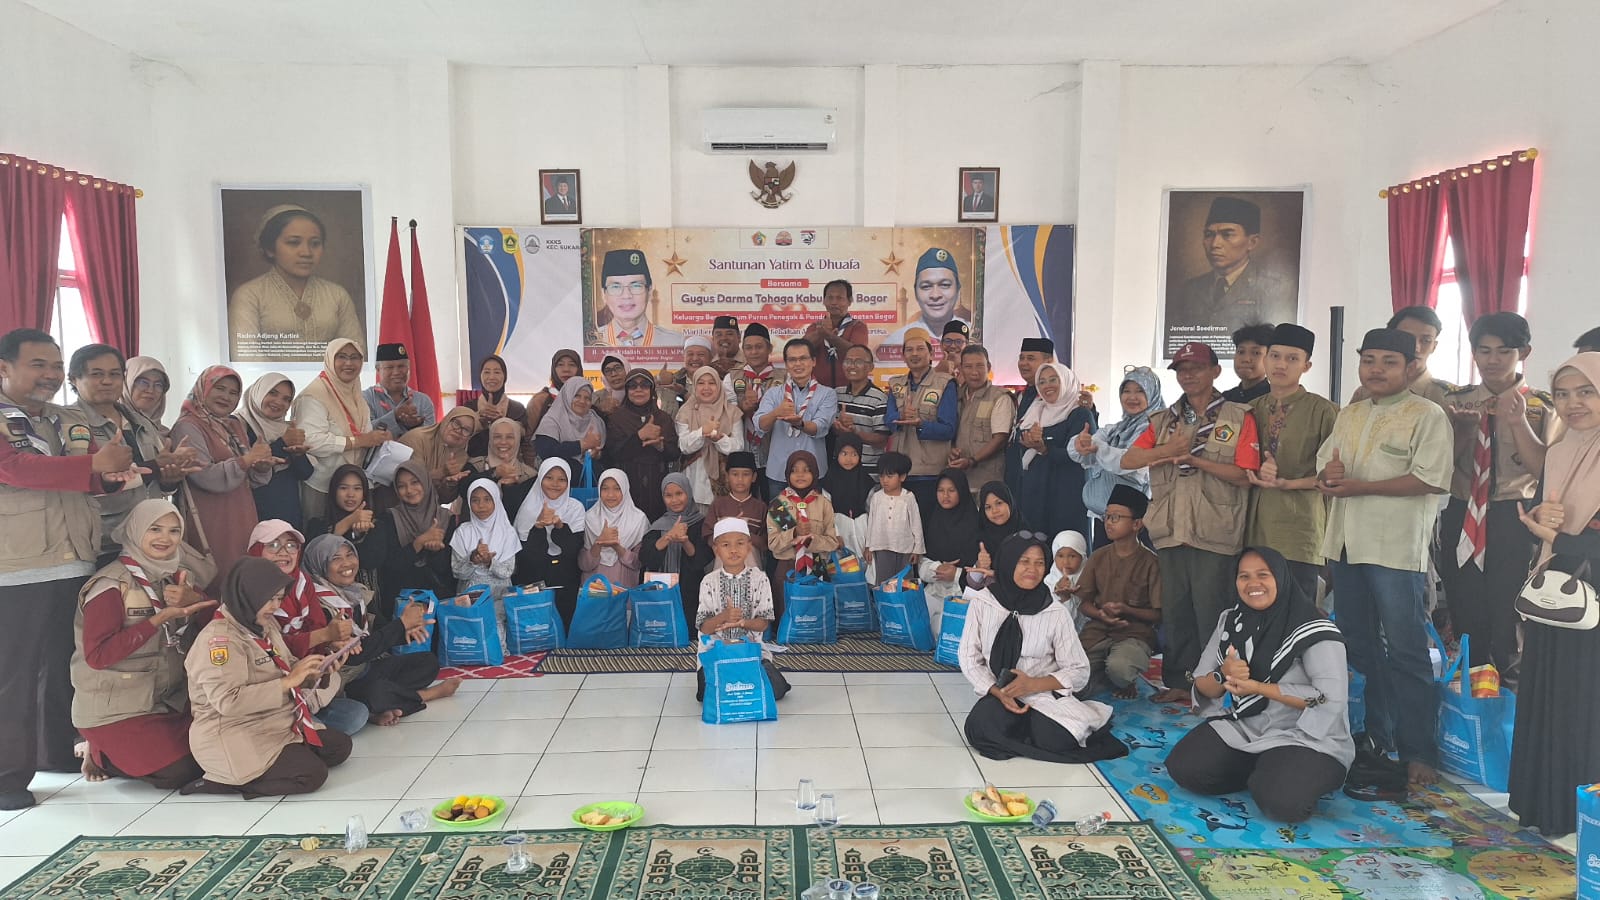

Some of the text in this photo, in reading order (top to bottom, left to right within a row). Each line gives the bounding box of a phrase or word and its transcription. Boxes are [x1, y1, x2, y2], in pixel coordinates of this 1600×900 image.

[709, 259, 860, 270] Santunan Yatim & Dhuafa
[681, 294, 715, 306] Gugus
[717, 294, 753, 303] Darma
[755, 294, 794, 305] Tohaga
[856, 294, 888, 305] Bogor
